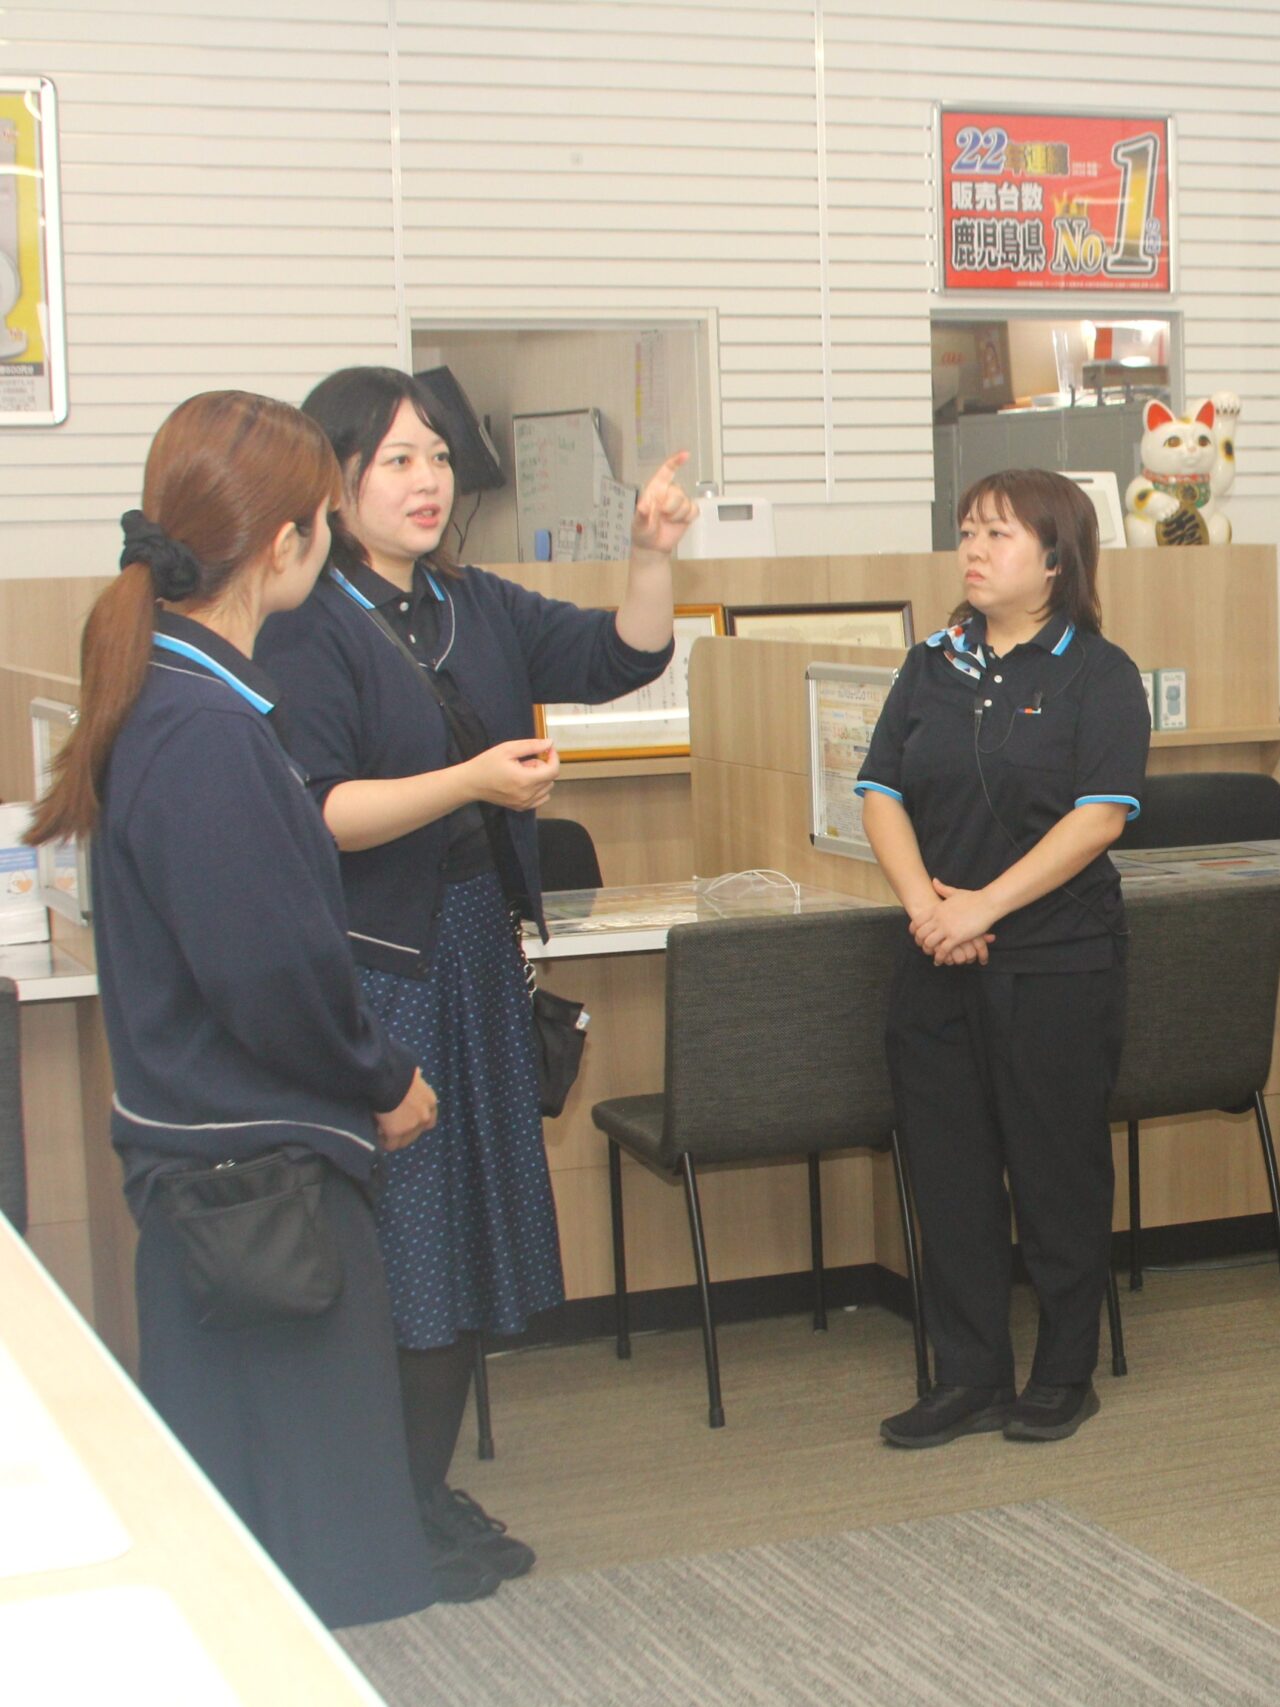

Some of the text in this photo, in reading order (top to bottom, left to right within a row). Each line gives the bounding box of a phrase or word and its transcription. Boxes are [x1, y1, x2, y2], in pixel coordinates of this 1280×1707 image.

[951, 182, 1044, 212] 販売台数
[951, 217, 1045, 272] 鹿児島県
